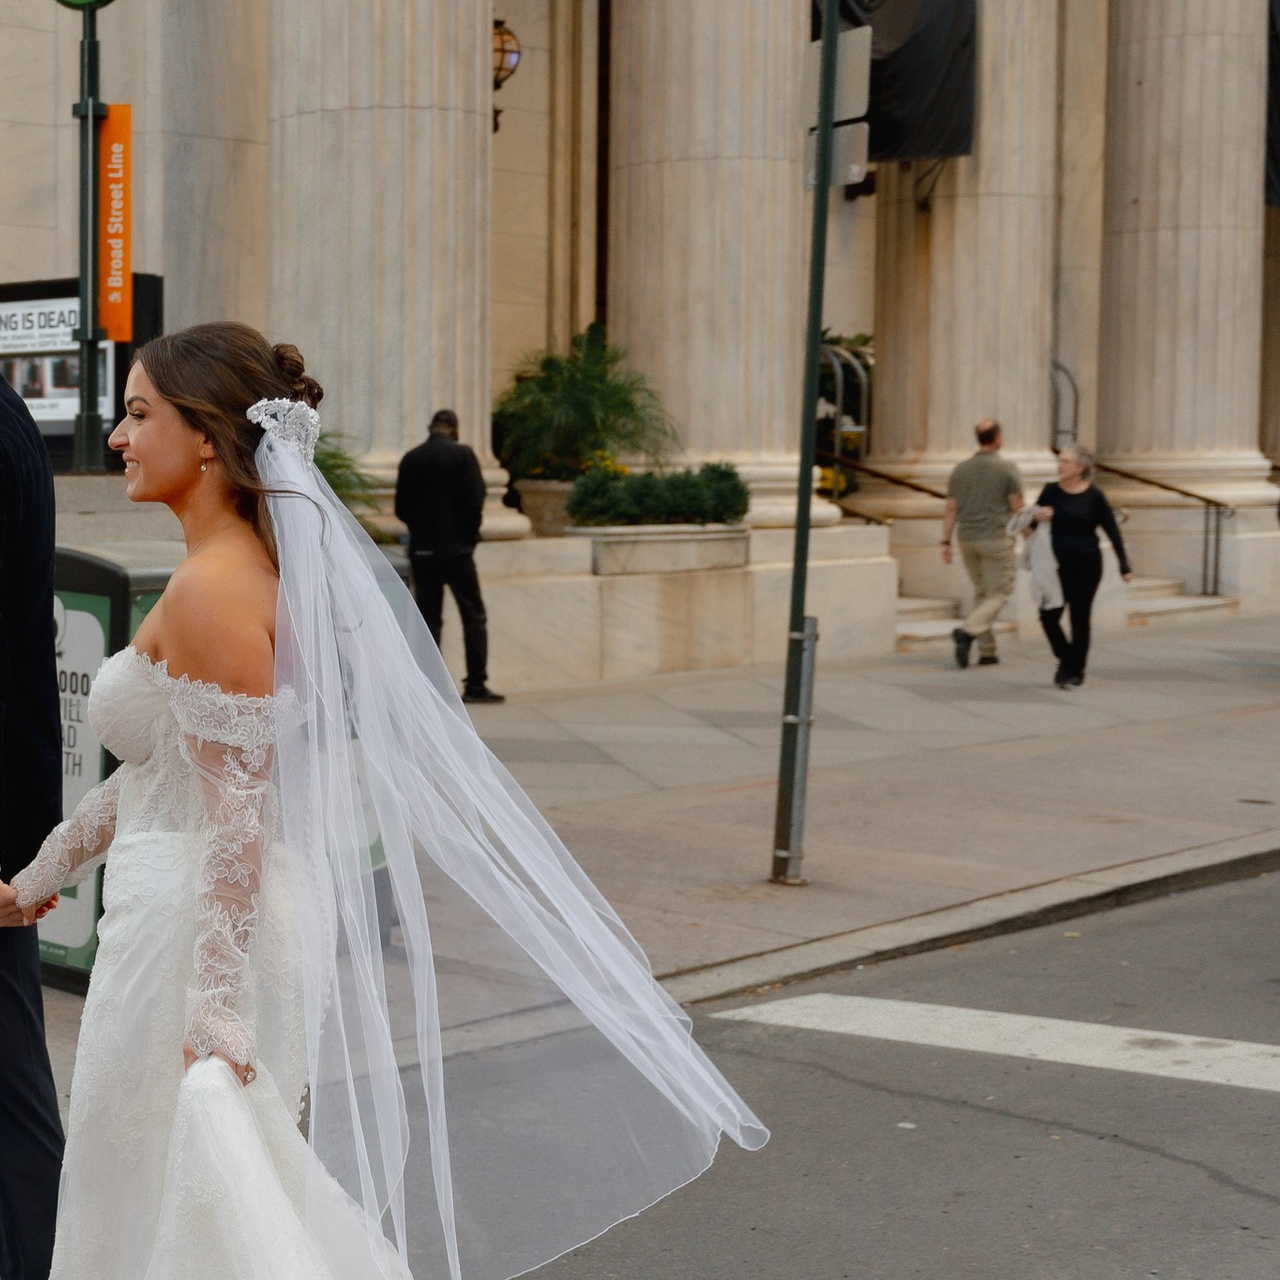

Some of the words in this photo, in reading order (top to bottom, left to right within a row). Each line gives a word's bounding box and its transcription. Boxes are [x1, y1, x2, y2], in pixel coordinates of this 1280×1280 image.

[107, 143, 124, 178] Line
[107, 183, 124, 234] Street
[107, 239, 124, 287] Broad
[22, 312, 34, 330] IS
[38, 310, 78, 329] DEAD
[60, 697, 83, 723] ILL
